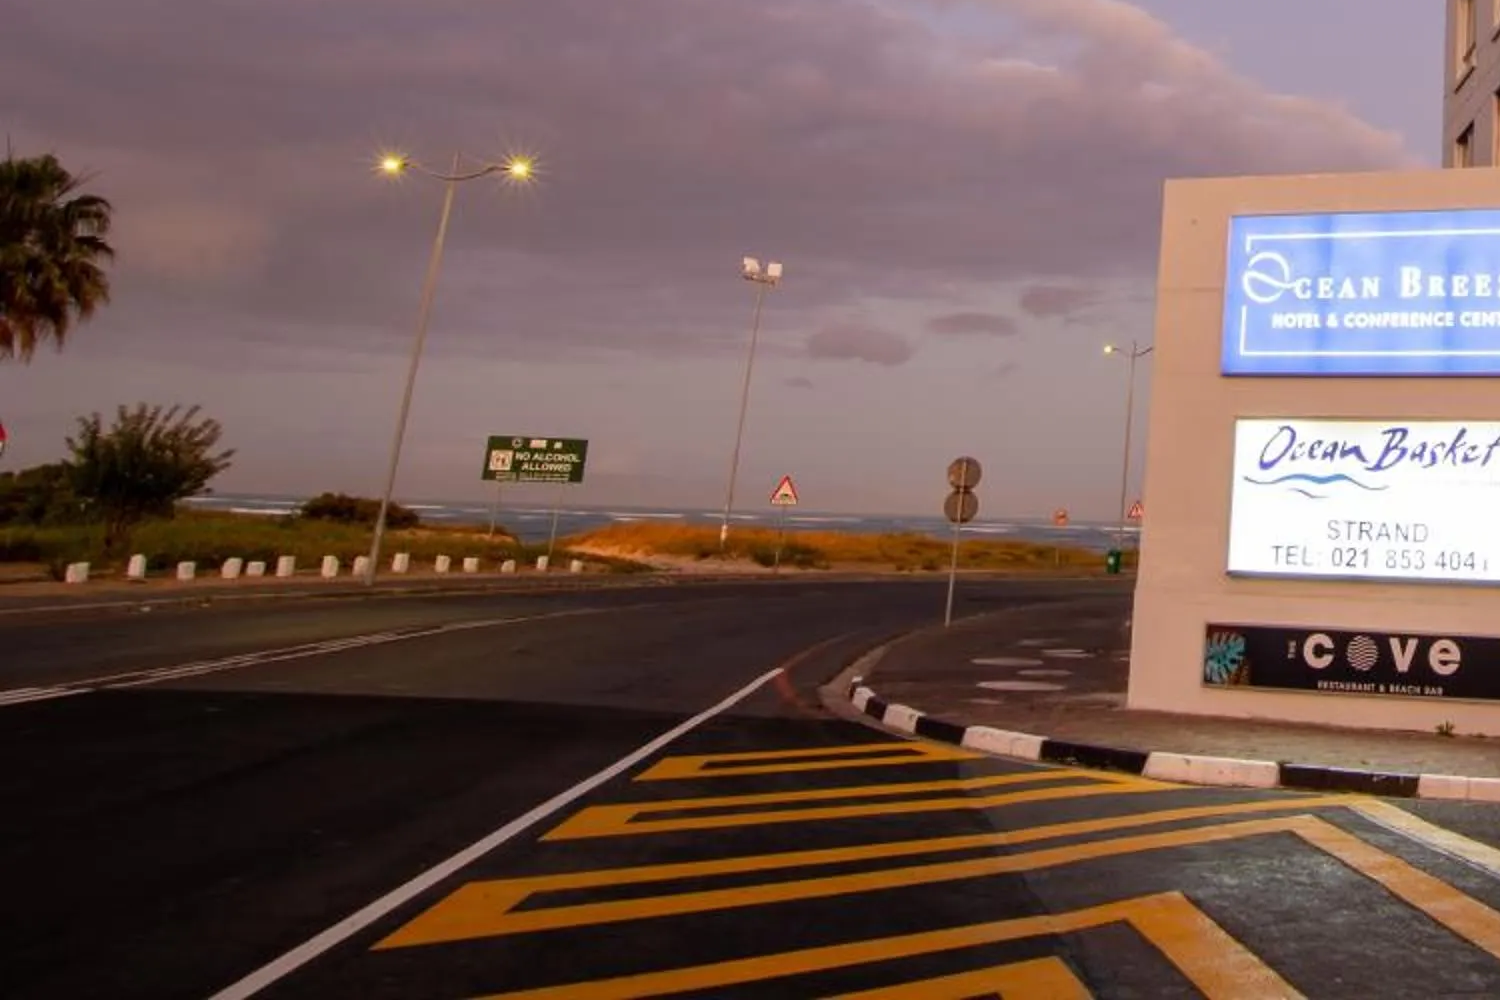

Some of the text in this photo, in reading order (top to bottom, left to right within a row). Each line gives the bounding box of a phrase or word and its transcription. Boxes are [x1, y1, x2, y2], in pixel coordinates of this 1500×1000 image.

[1243, 252, 1380, 302] OCEAN
[1271, 312, 1321, 329] HOTEL
[1326, 312, 1339, 328] &
[1343, 311, 1455, 328] CONFERENCE
[515, 451, 581, 463] NO ALCOHOL
[1259, 426, 1368, 470] Ocean
[521, 462, 572, 472] ALLOWED
[1327, 520, 1429, 543] STRAND
[1331, 547, 1370, 568] 021
[1385, 549, 1425, 570] 853
[1317, 681, 1375, 691] RESTAURANT
[1389, 685, 1421, 695] BEACH
[1424, 687, 1444, 696] BAR
